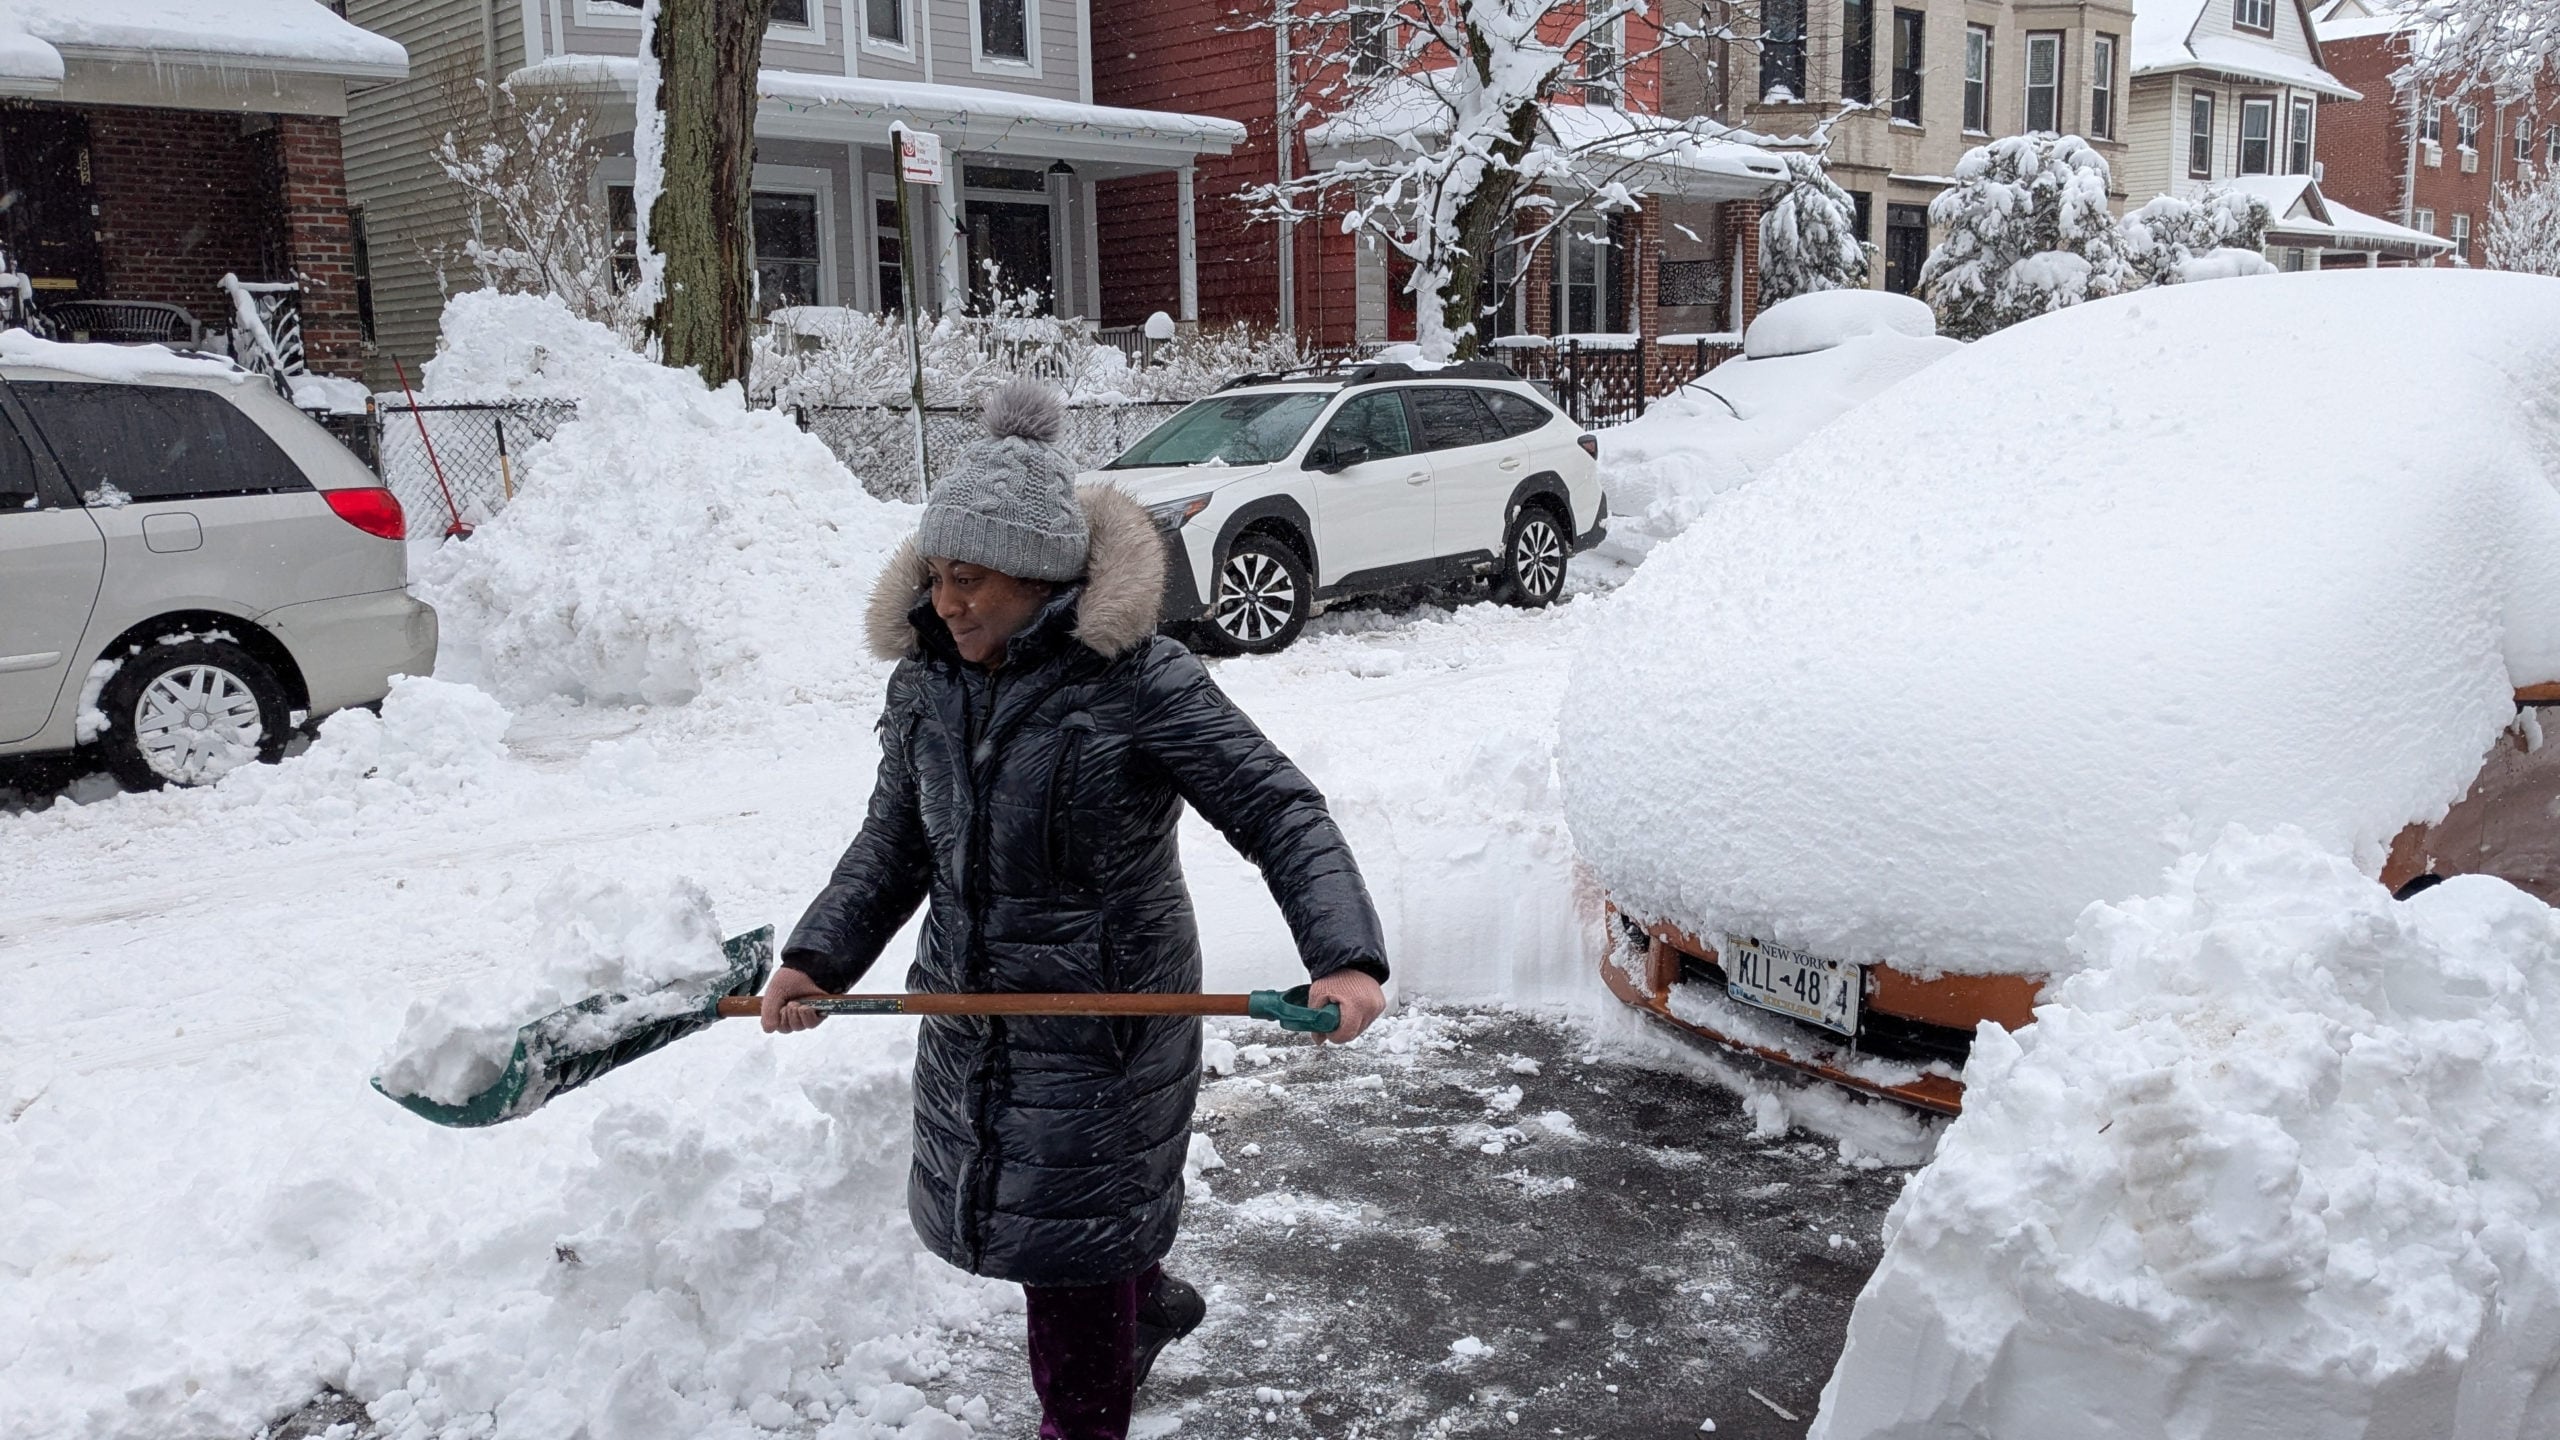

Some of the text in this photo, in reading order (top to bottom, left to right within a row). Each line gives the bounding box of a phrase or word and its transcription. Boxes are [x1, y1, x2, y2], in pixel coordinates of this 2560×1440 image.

[81, 150, 89, 184] 282
[1761, 944, 1828, 971] NEW YORK
[1739, 950, 1848, 1015] KLL 484
